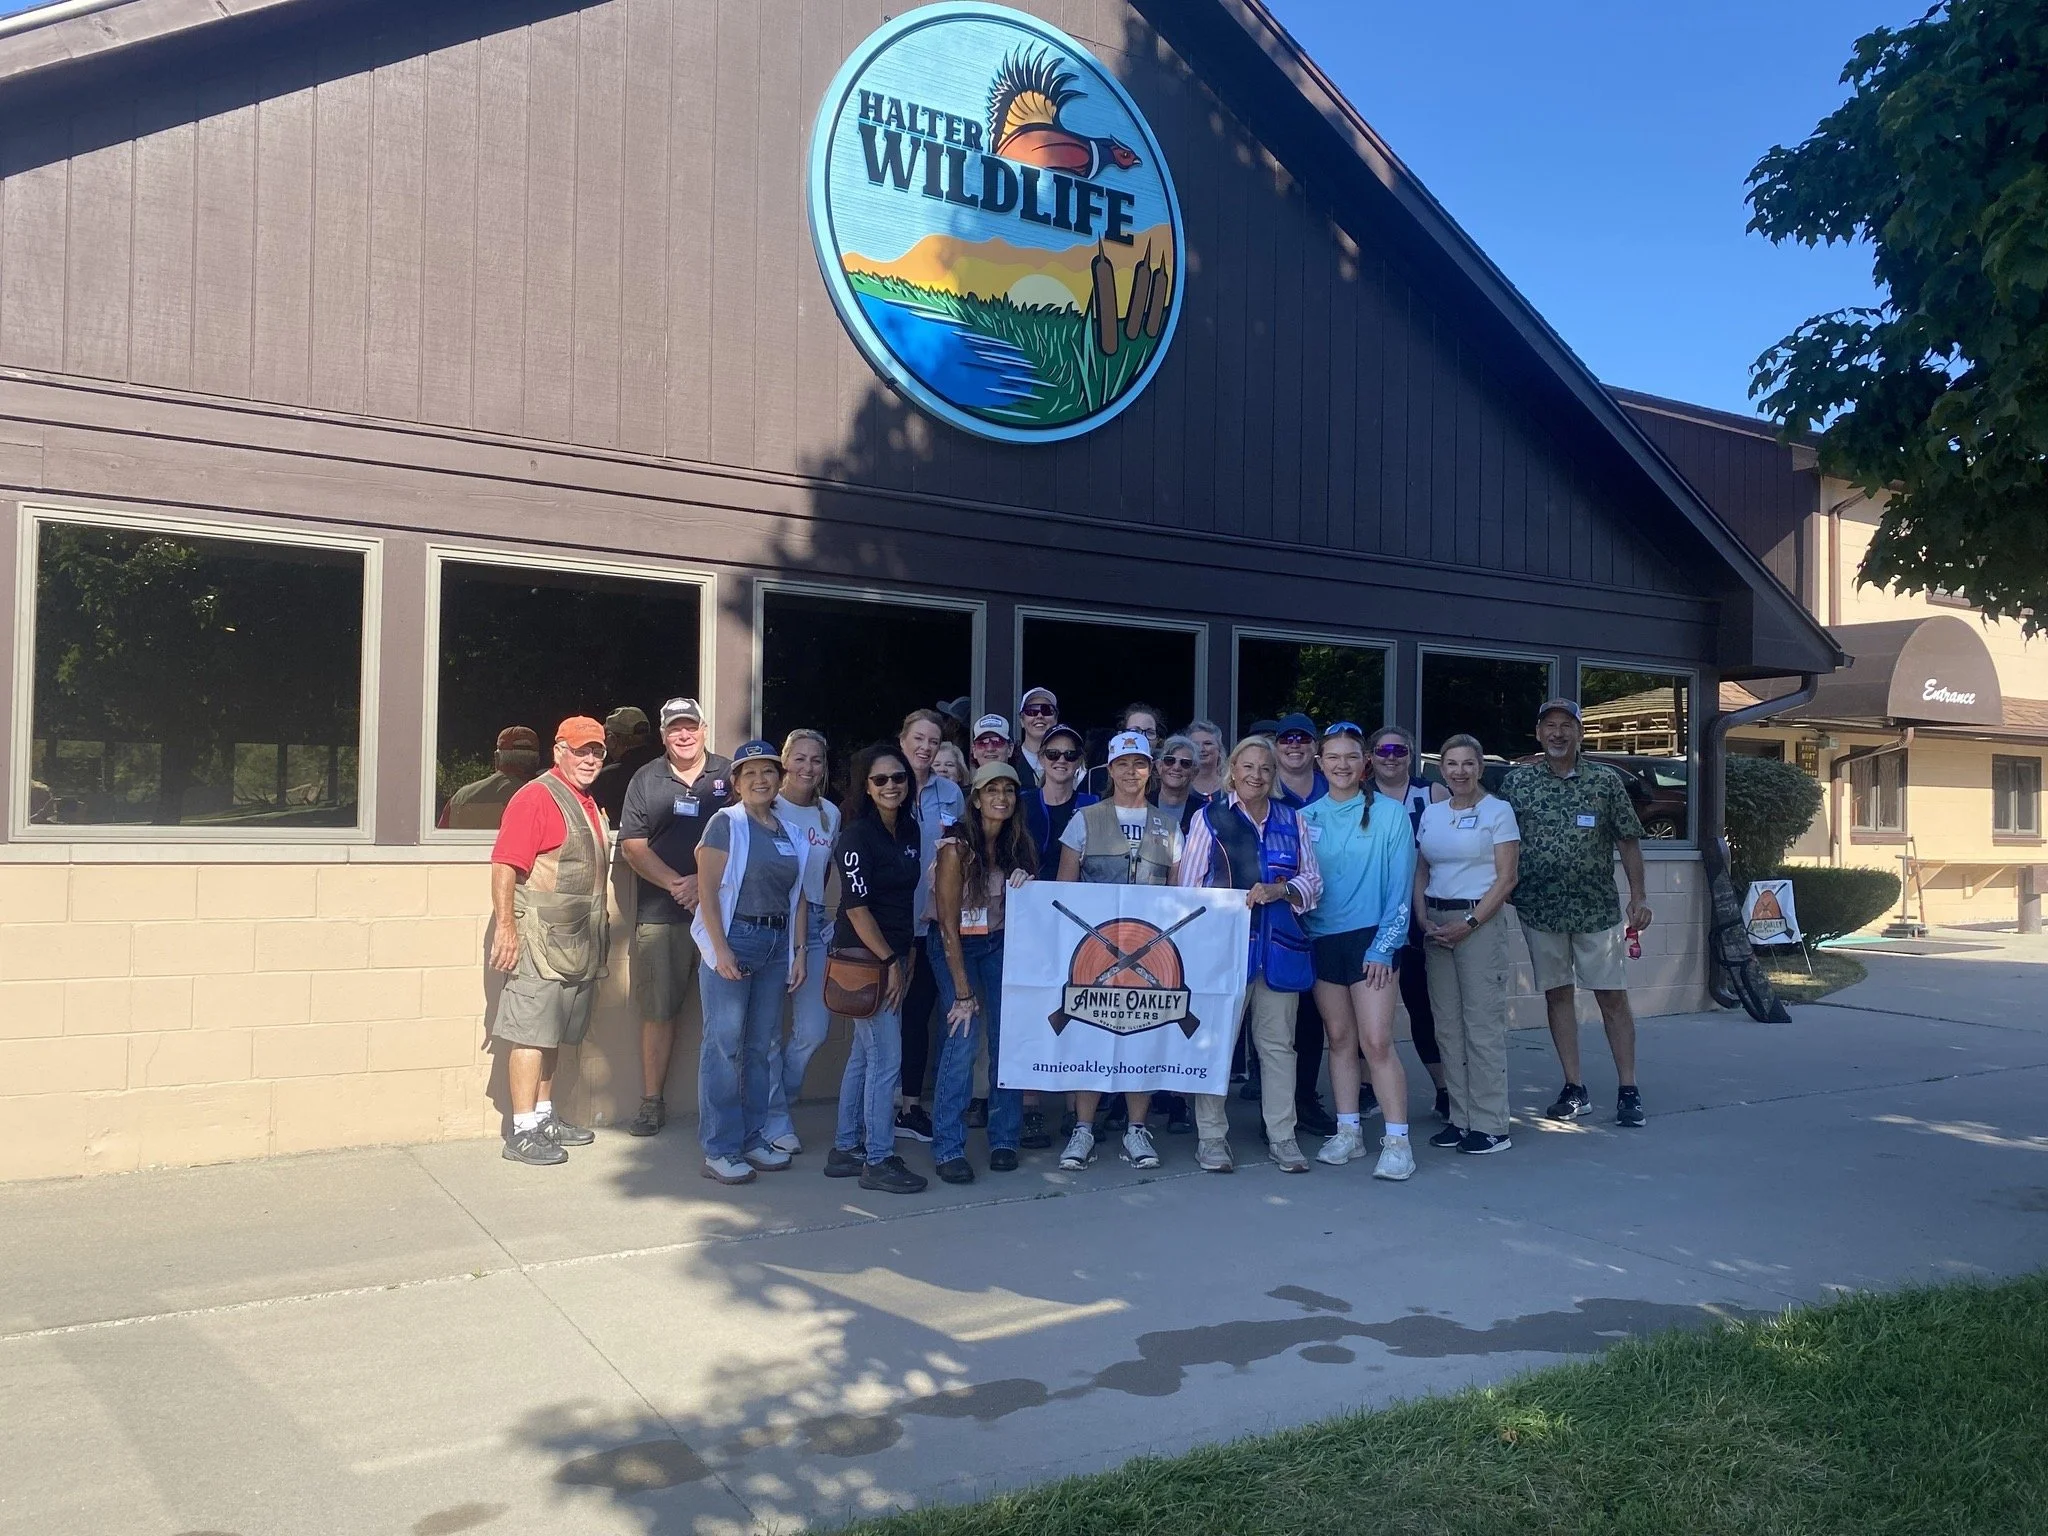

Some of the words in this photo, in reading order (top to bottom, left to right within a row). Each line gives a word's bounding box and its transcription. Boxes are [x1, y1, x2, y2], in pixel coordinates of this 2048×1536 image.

[858, 88, 983, 152] HALTER
[858, 122, 1135, 246] WILDLIFE
[1922, 678, 1976, 704] Entrance
[1070, 988, 1121, 1011] ANNIE
[1126, 990, 1182, 1010] OAKLEY
[1092, 1010, 1159, 1020] SHOOTERS
[1032, 1060, 1208, 1079] annieoakleyshootersni.org
